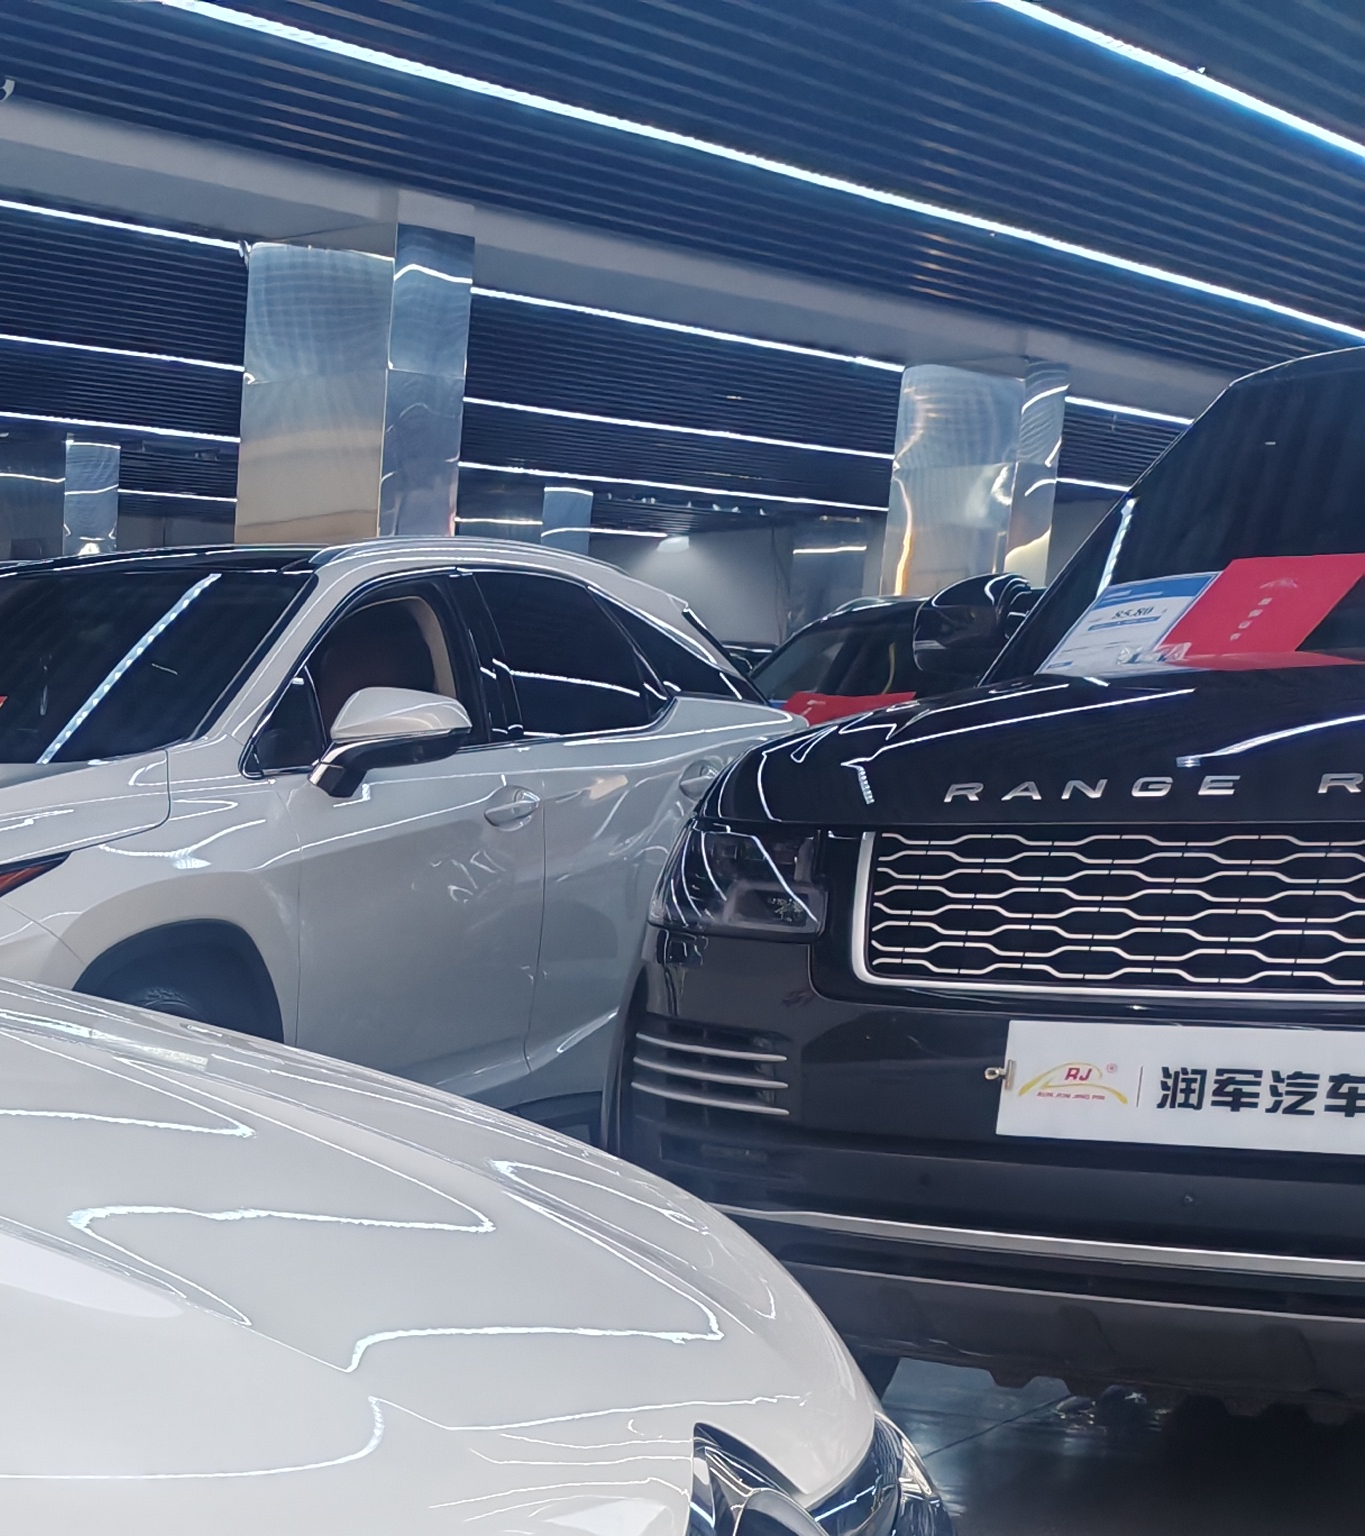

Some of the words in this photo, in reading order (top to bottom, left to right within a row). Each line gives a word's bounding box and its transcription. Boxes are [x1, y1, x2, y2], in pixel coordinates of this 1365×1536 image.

[944, 775, 1241, 802] RANGE
[1065, 1067, 1093, 1081] RJ
[1156, 1066, 1365, 1118] 润军汽车
